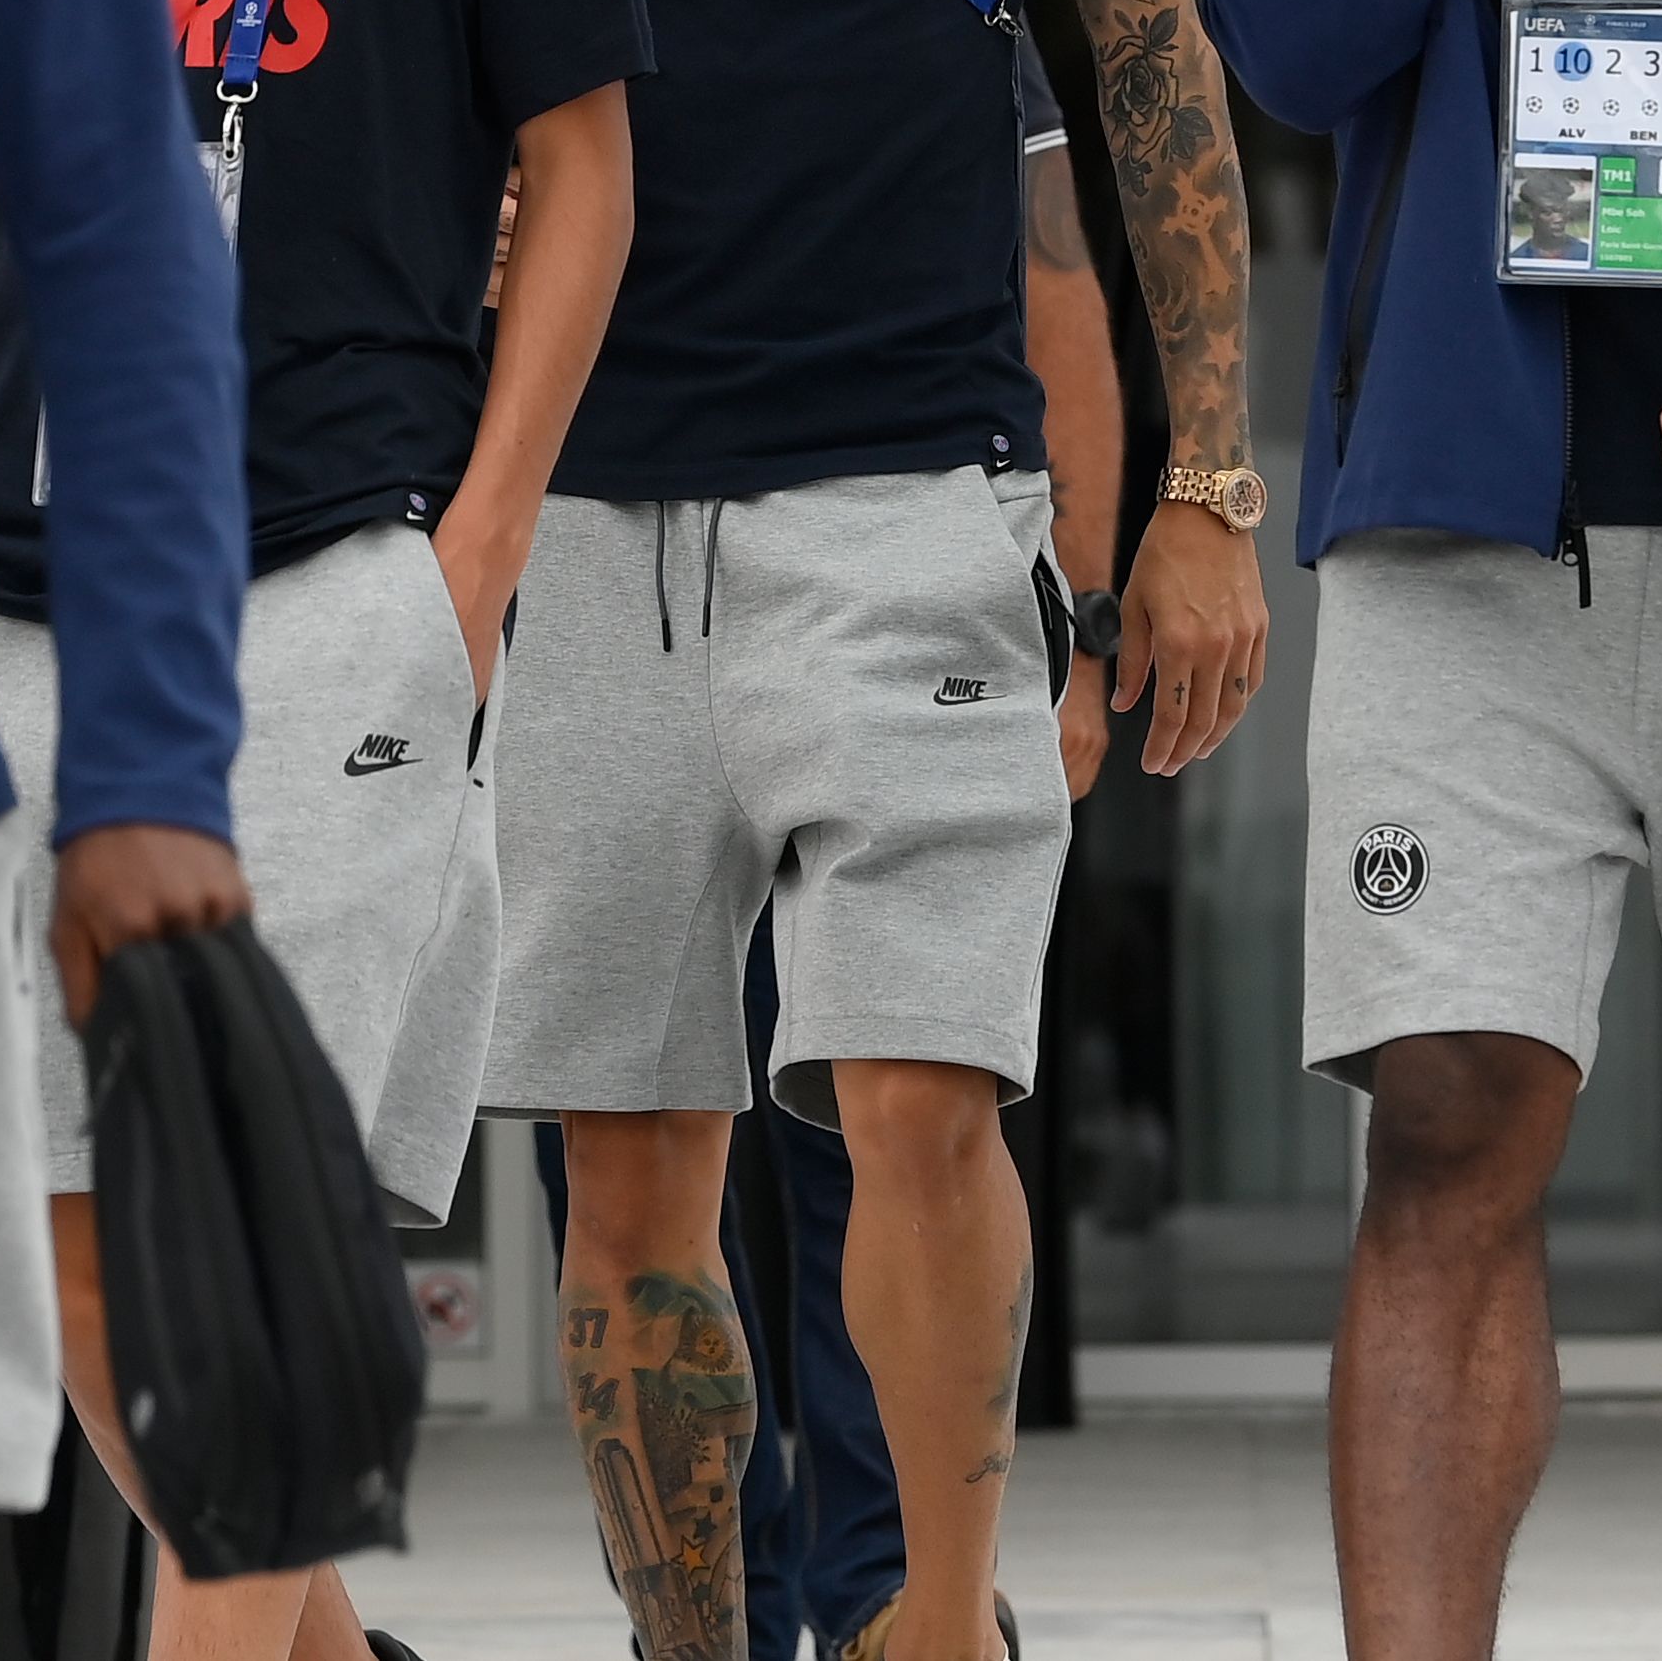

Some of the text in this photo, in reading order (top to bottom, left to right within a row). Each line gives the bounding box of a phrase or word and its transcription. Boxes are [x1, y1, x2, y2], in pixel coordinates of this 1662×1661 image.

[1524, 17, 1566, 32] UEFA
[1530, 47, 1543, 72] 1
[1557, 48, 1591, 74] 10
[1605, 49, 1622, 75] 2
[1644, 50, 1660, 76] 3
[1558, 128, 1658, 141] ALV BEN
[1603, 169, 1633, 182] TM1
[1362, 830, 1415, 852] PARIS
